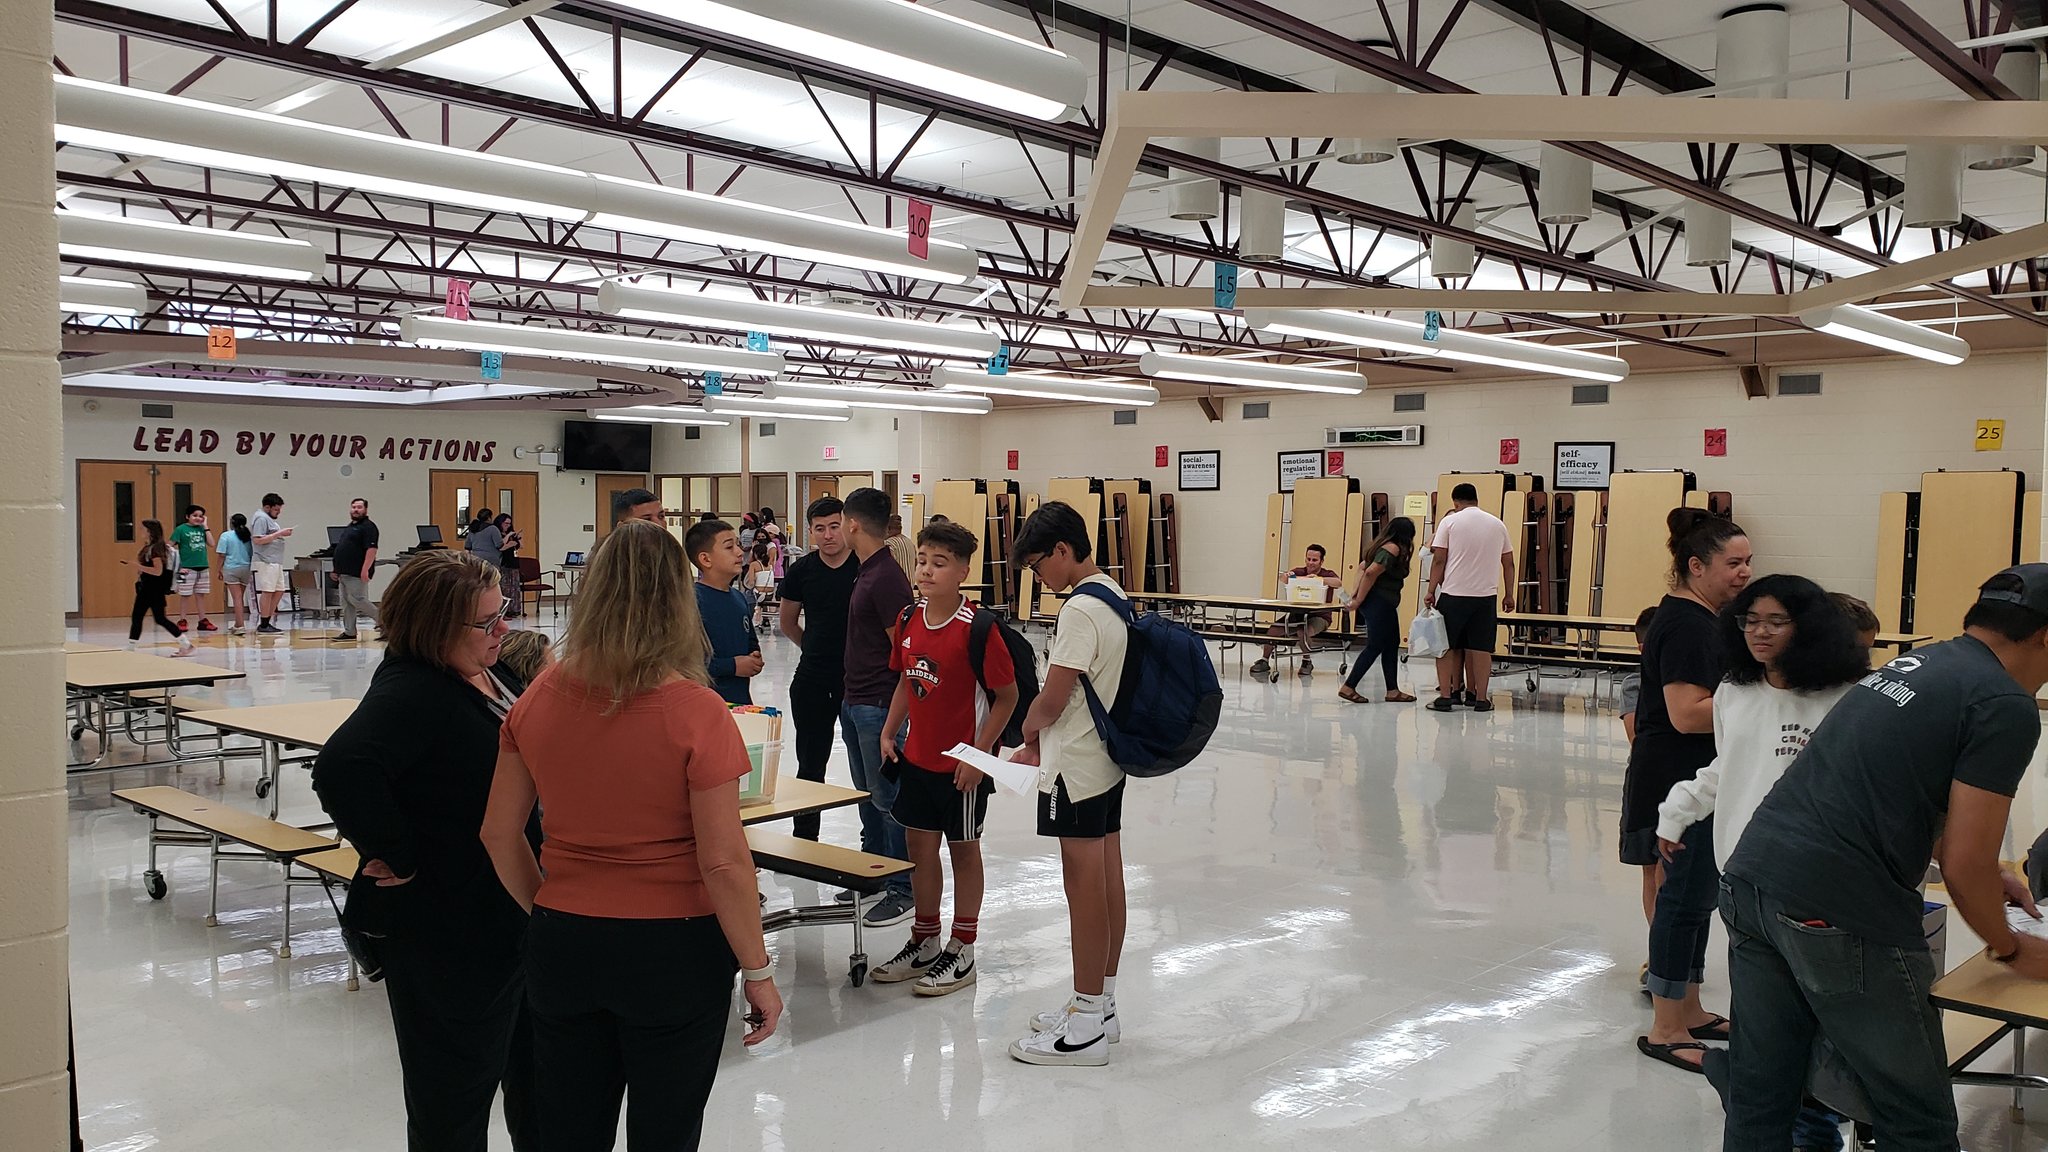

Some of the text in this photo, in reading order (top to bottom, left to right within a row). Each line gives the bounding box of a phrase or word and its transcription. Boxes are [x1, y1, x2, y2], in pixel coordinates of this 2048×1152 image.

[910, 214, 927, 239] 10
[1217, 274, 1234, 293] 15
[447, 288, 466, 307] 11
[1425, 311, 1438, 328] 16
[211, 335, 233, 348] 12
[484, 357, 500, 370] 13
[991, 354, 1008, 368] 17
[706, 376, 721, 386] 18
[1977, 427, 2000, 440] 25
[133, 426, 497, 463] LEAD BY YOUR ACTIONS
[1706, 435, 1723, 446] 24
[1560, 450, 1580, 458] self-
[1282, 457, 1318, 465] emotional-
[1329, 456, 1343, 467] 22
[1560, 460, 1598, 470] efficacy
[1282, 465, 1316, 473] regulation
[906, 669, 939, 684] RAIDERS
[1880, 679, 1917, 708] viking
[1781, 723, 1800, 732] RED
[1781, 735, 1807, 747] CHIL
